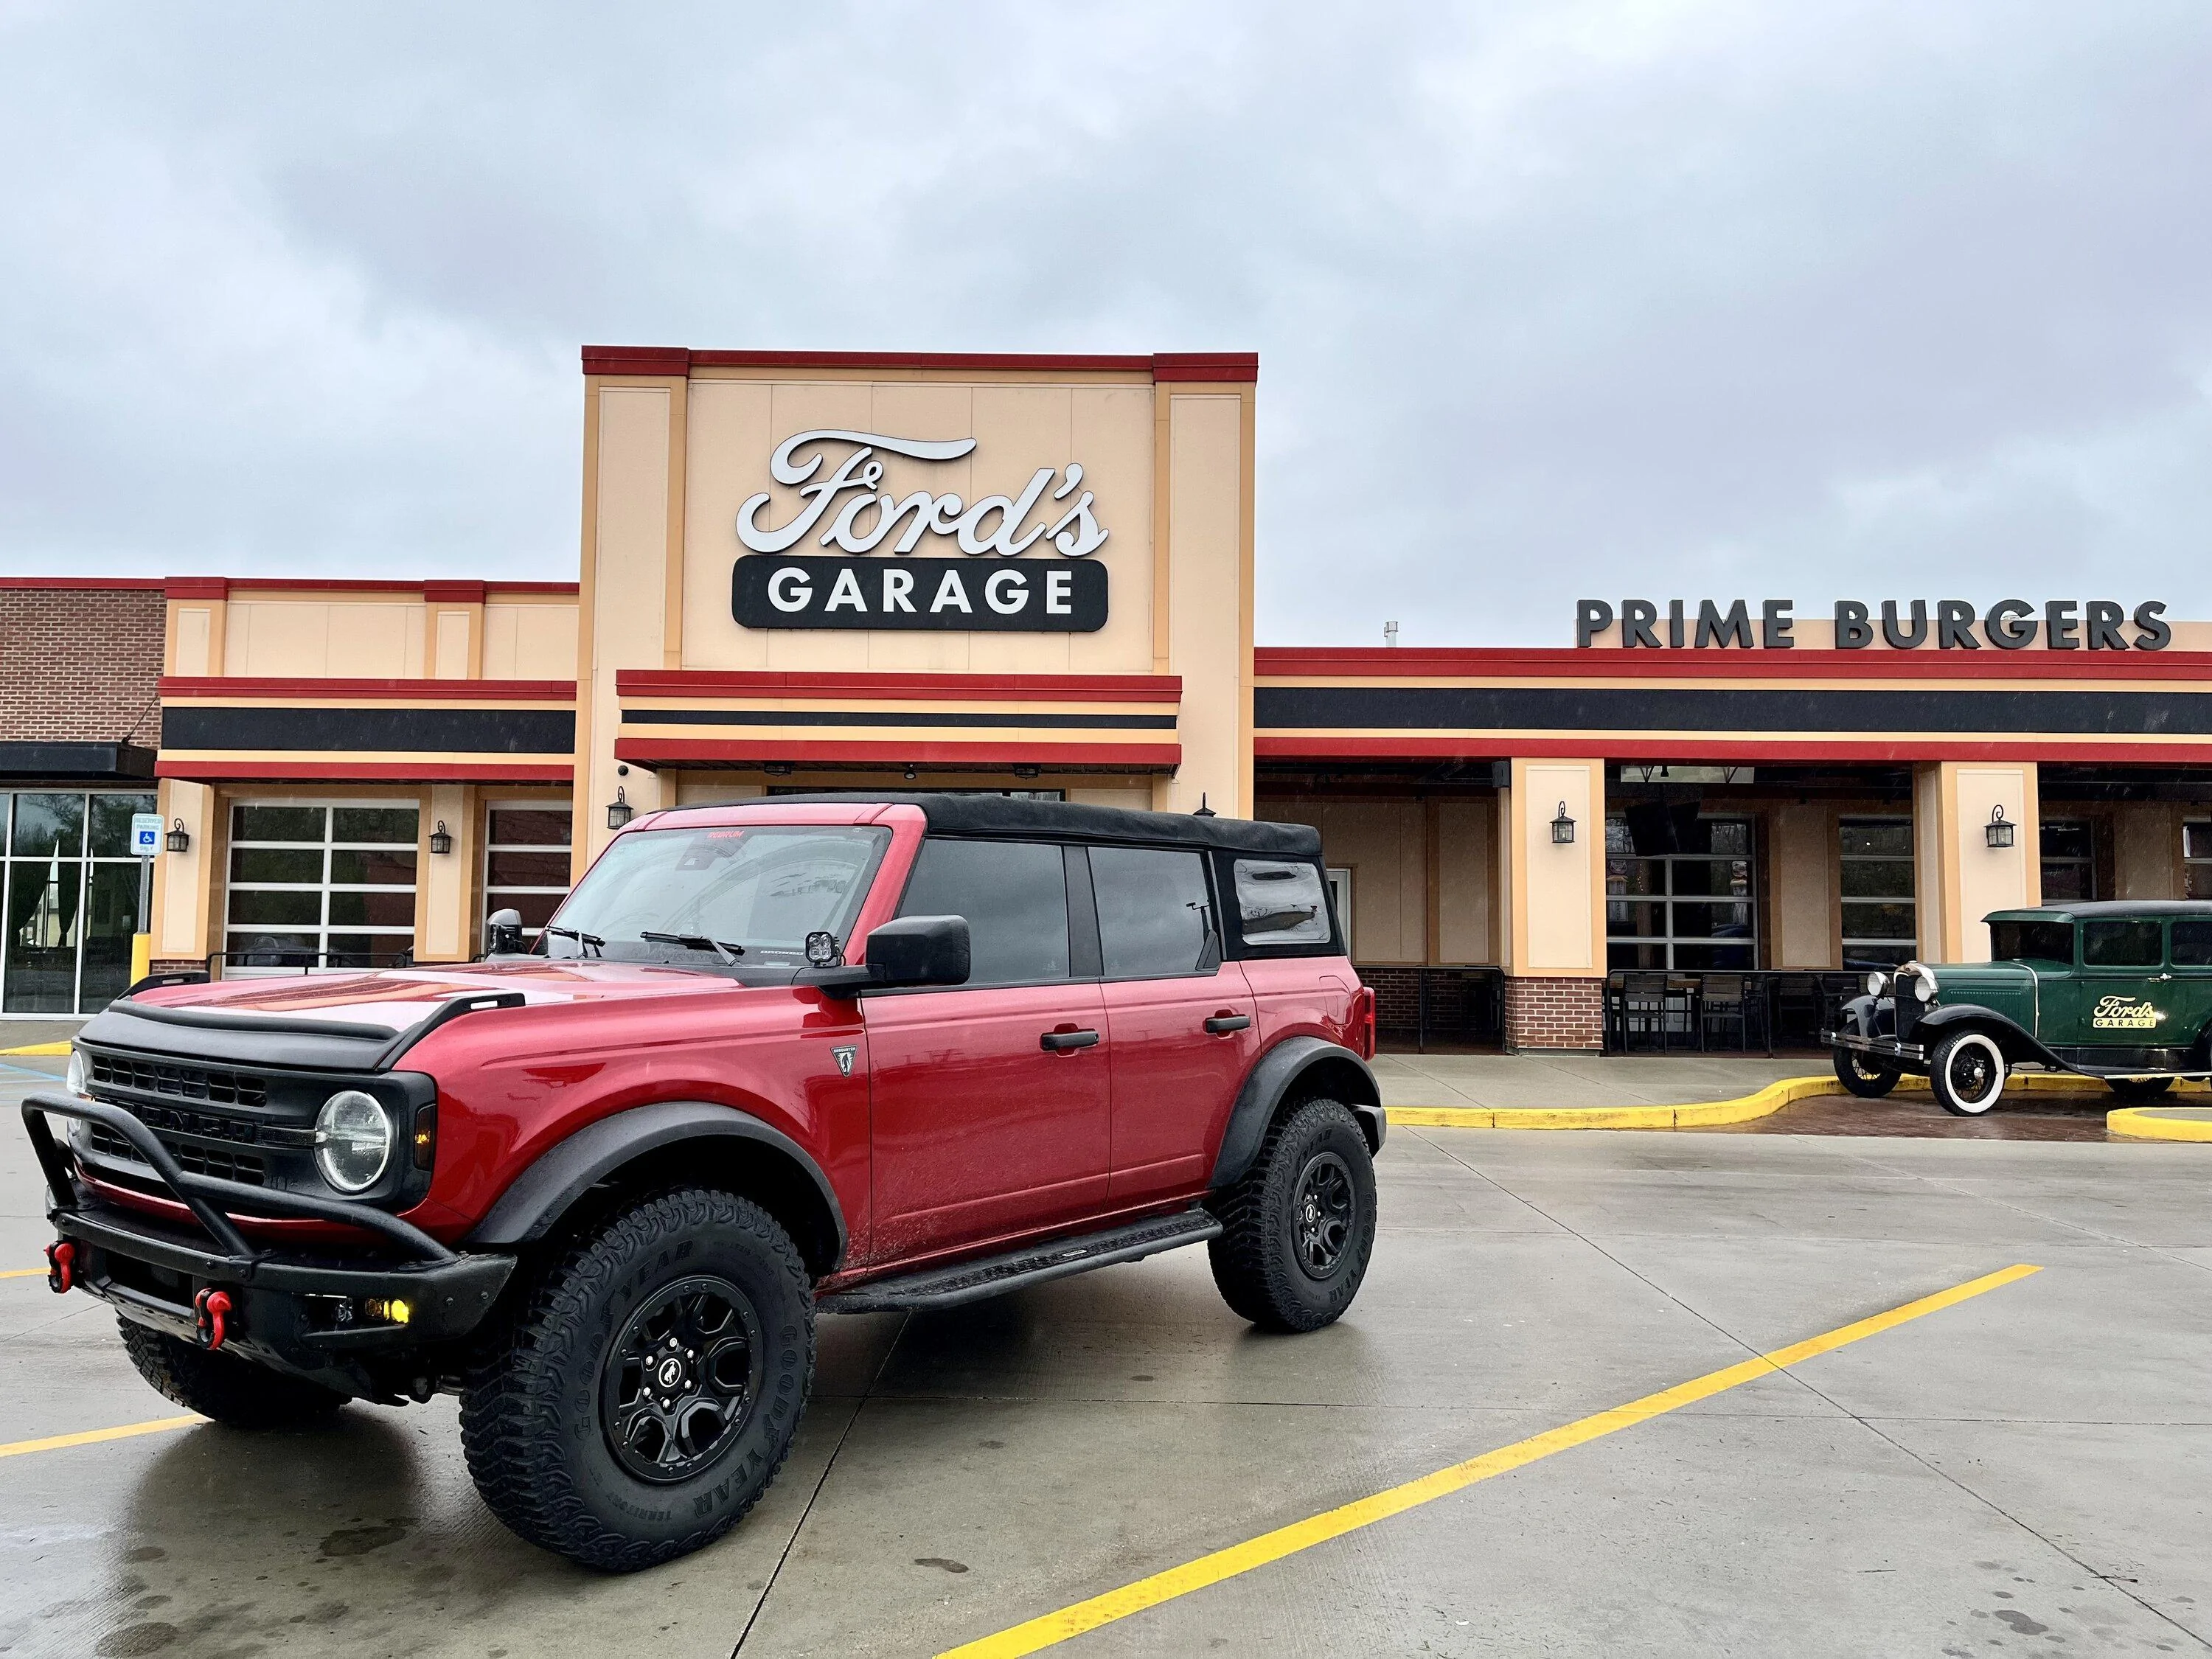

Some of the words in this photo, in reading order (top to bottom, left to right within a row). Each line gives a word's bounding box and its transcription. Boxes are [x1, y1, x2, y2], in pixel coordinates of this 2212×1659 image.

[736, 428, 1110, 557] Ford's
[768, 566, 1072, 615] GARAGE
[1576, 599, 1795, 649] PRIME
[1834, 599, 2173, 652] BURGERS
[2095, 1019, 2154, 1027] GARAGE
